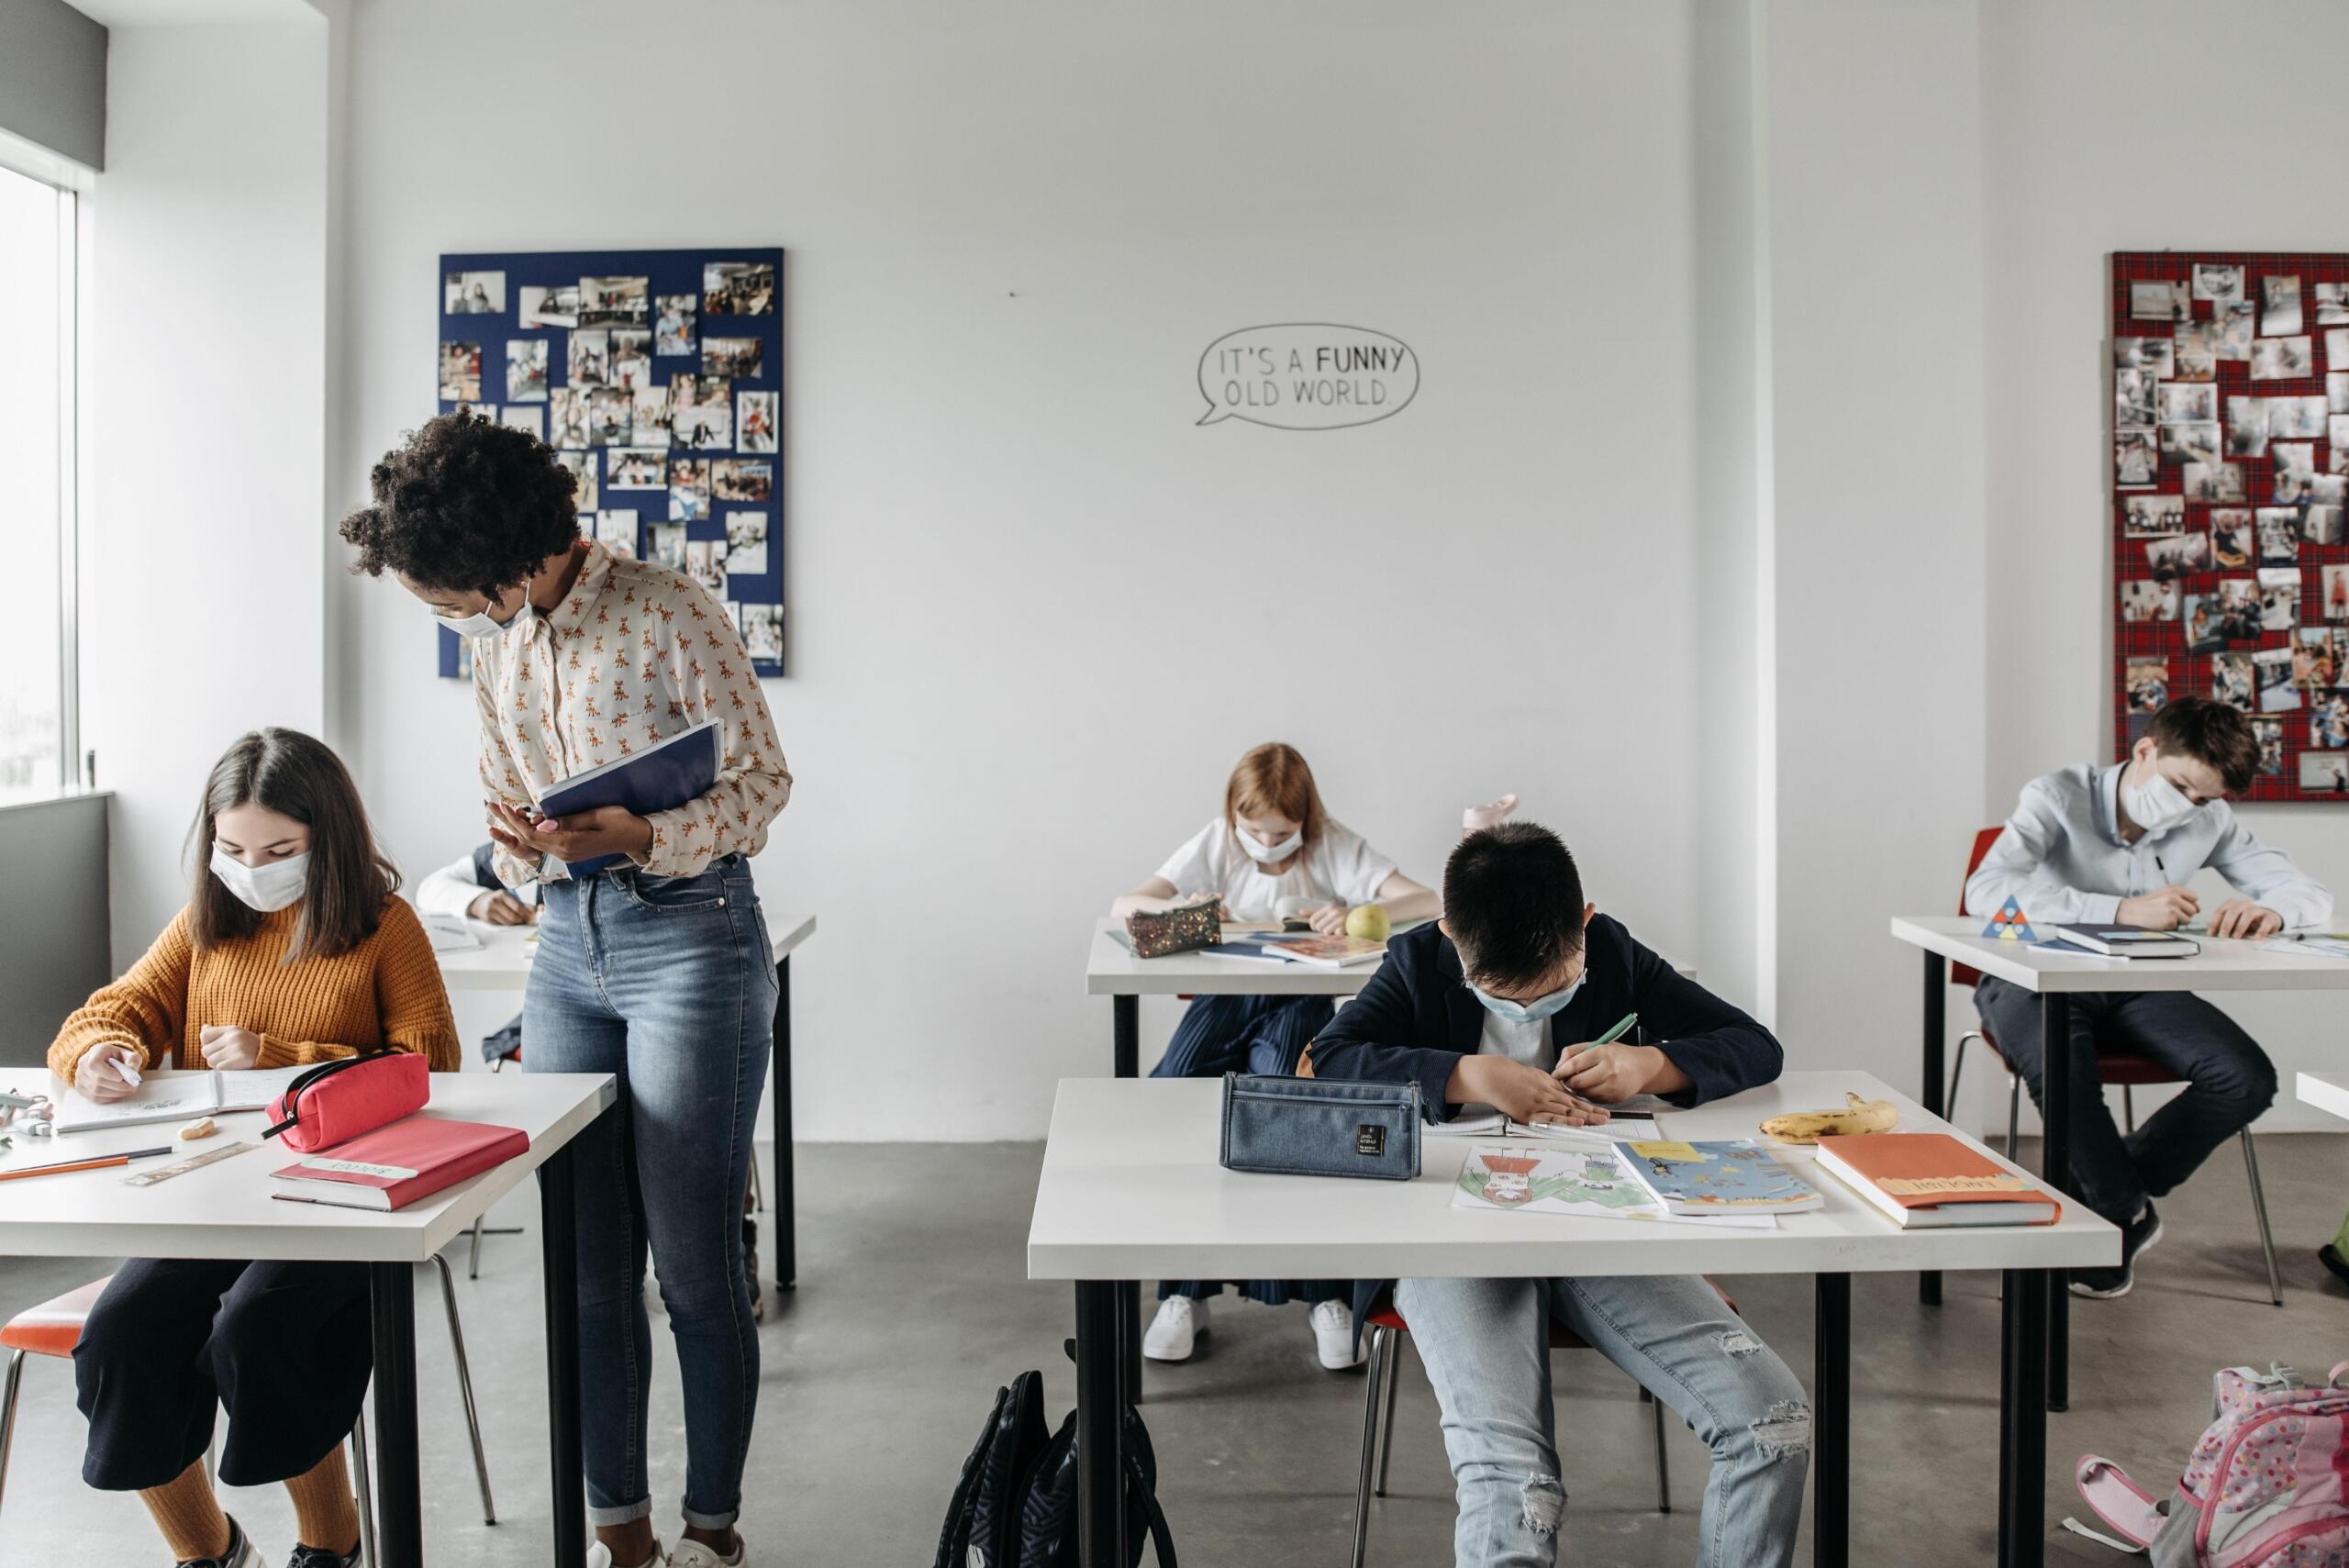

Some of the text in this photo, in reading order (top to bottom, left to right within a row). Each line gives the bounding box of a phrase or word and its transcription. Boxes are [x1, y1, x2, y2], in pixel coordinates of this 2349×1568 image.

[1220, 346, 1405, 376] IT'S A FUNNY
[1225, 380, 1279, 406] OLD
[1912, 1181, 1998, 1190] ENGLISH
